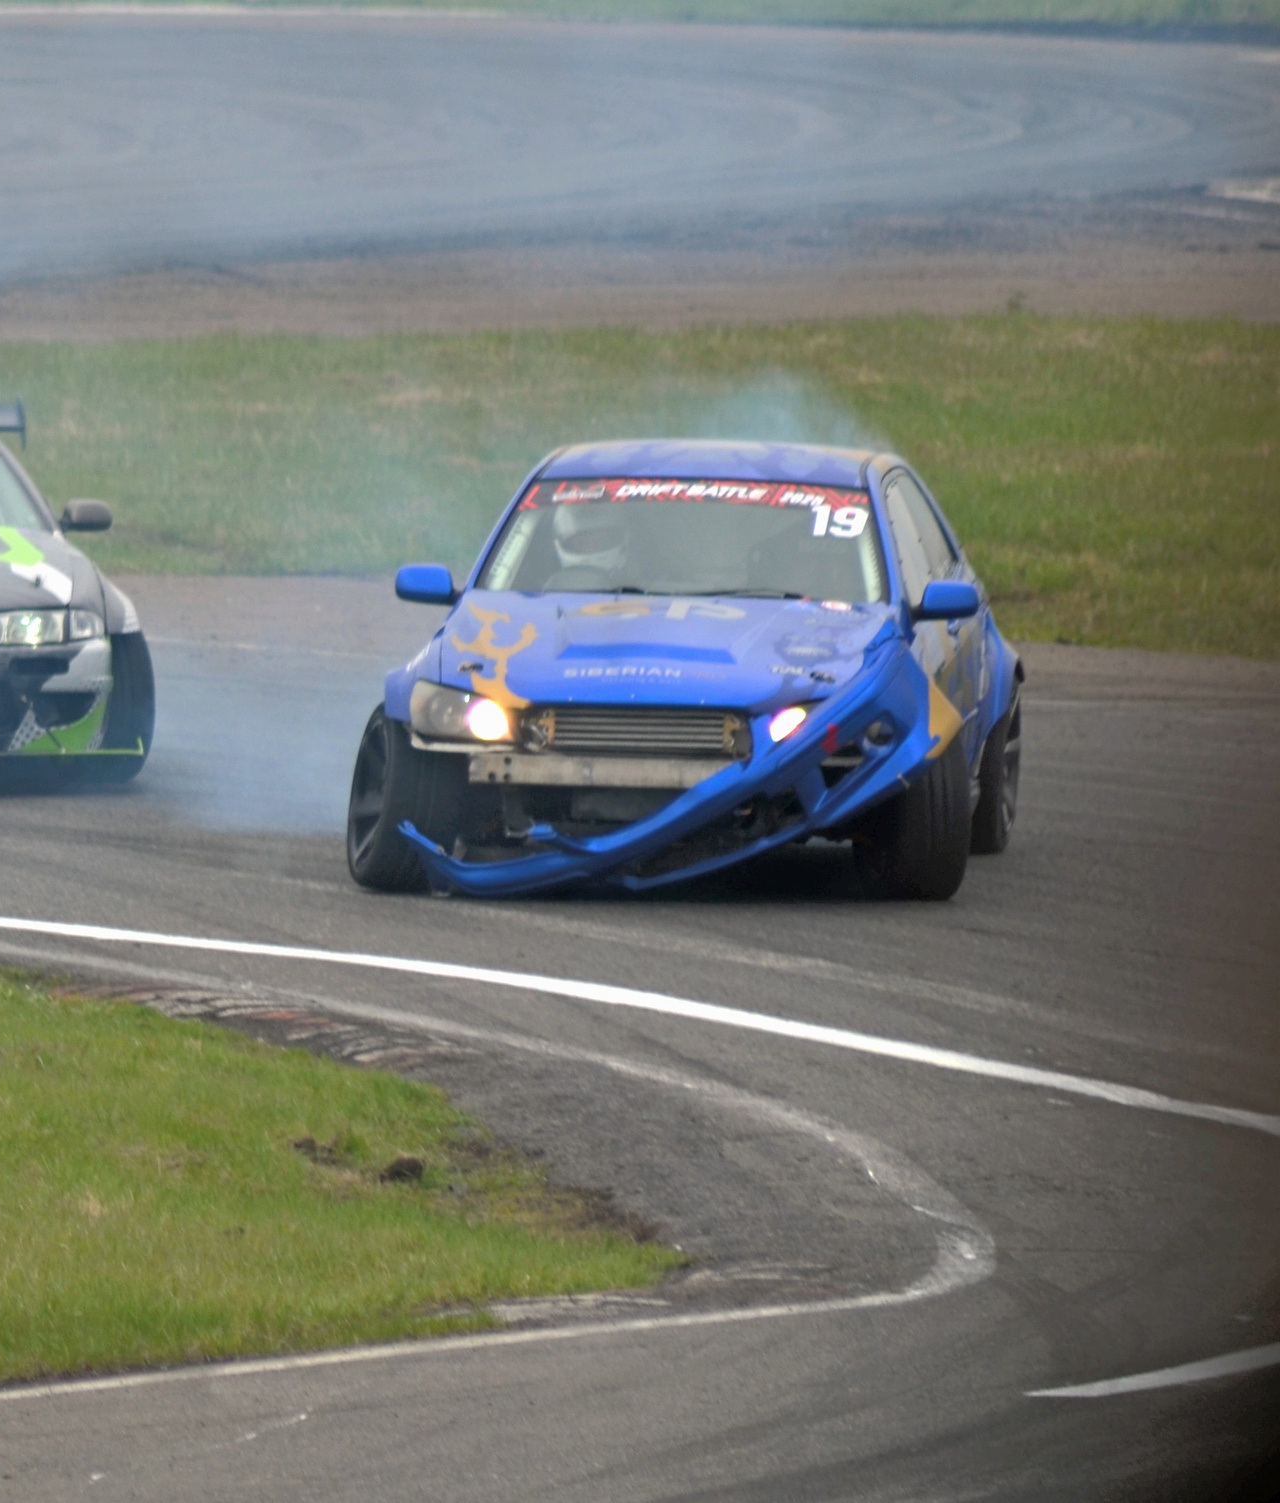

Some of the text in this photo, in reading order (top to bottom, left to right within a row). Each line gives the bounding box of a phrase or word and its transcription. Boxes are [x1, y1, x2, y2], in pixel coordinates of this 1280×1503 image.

[616, 483, 688, 497] DRIFT
[686, 484, 768, 500] BATTLE
[811, 504, 869, 538] 19
[563, 666, 682, 679] SIBERIAN
